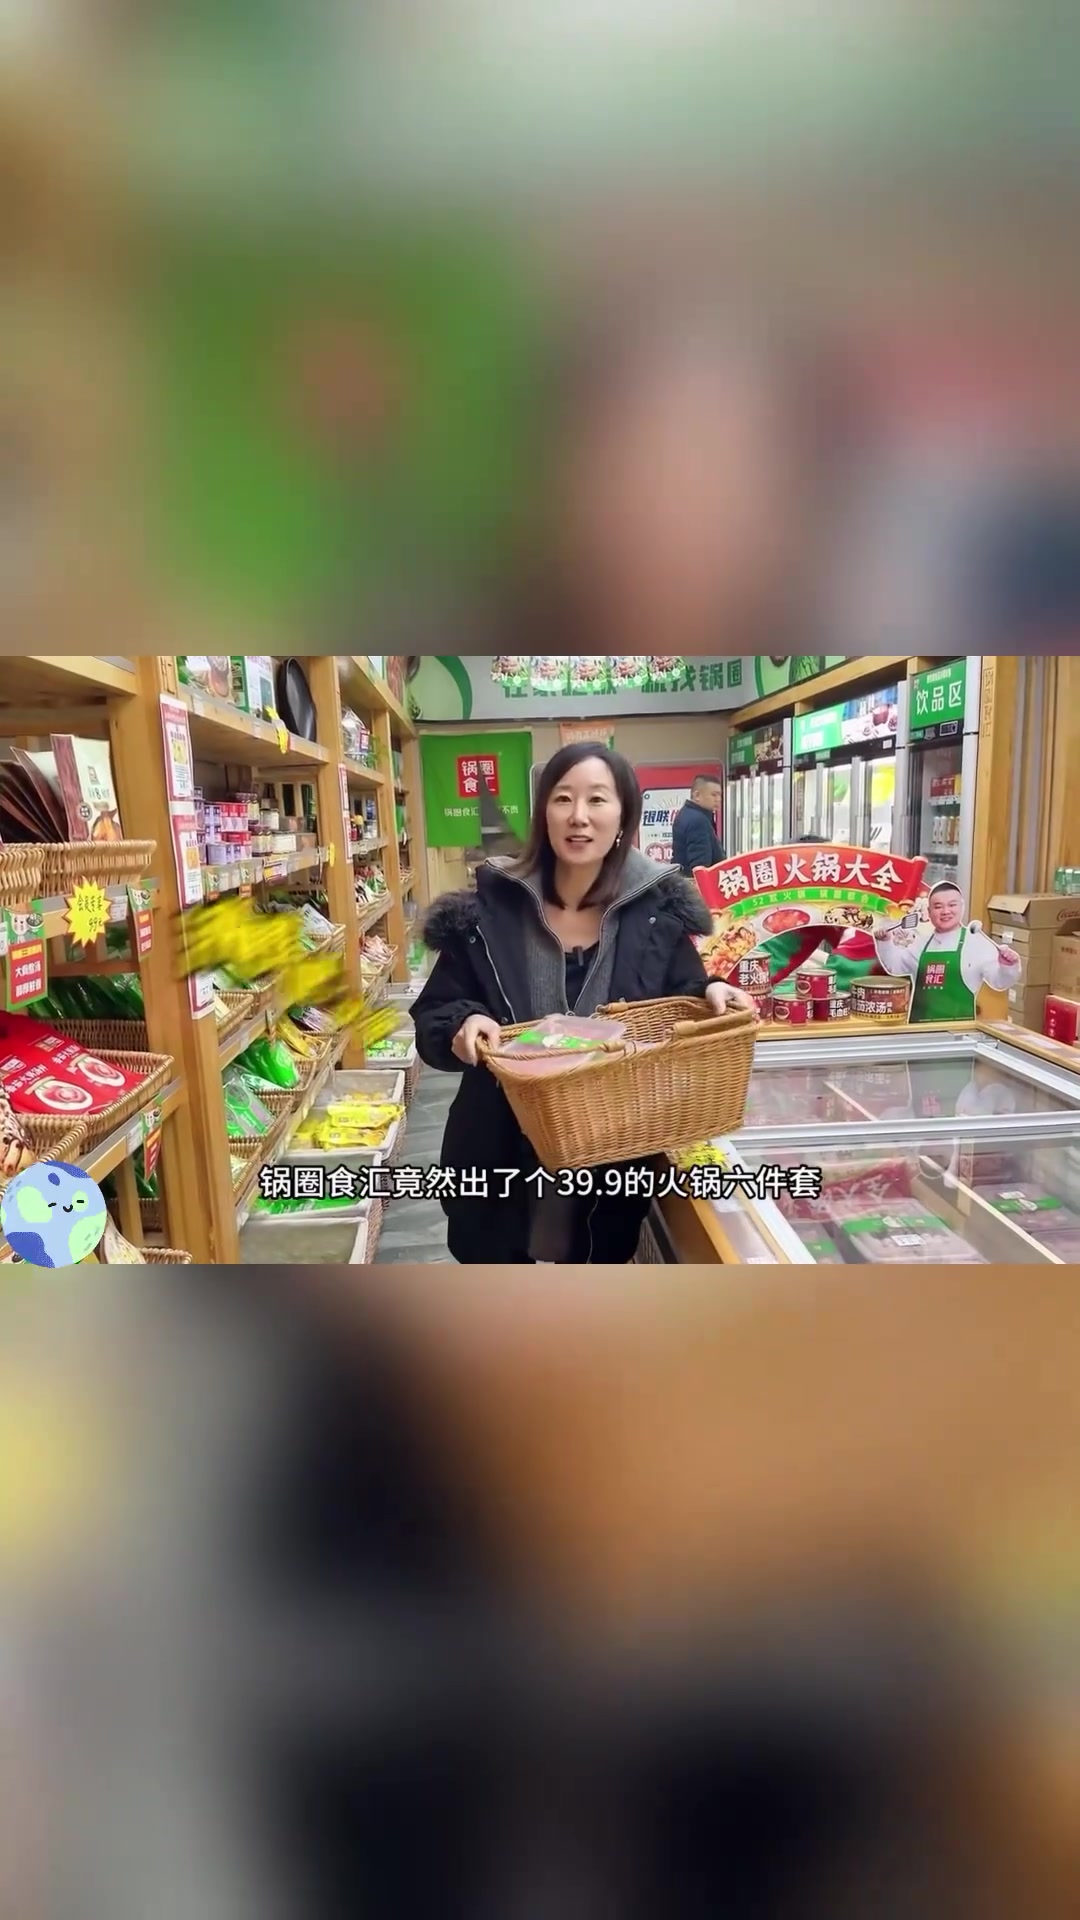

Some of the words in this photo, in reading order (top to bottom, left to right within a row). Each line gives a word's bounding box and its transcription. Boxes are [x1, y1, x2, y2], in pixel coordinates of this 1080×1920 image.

[916, 681, 962, 715] 饮品区
[461, 760, 495, 777] 锅圈
[718, 851, 904, 900] 锅圈火锅大全
